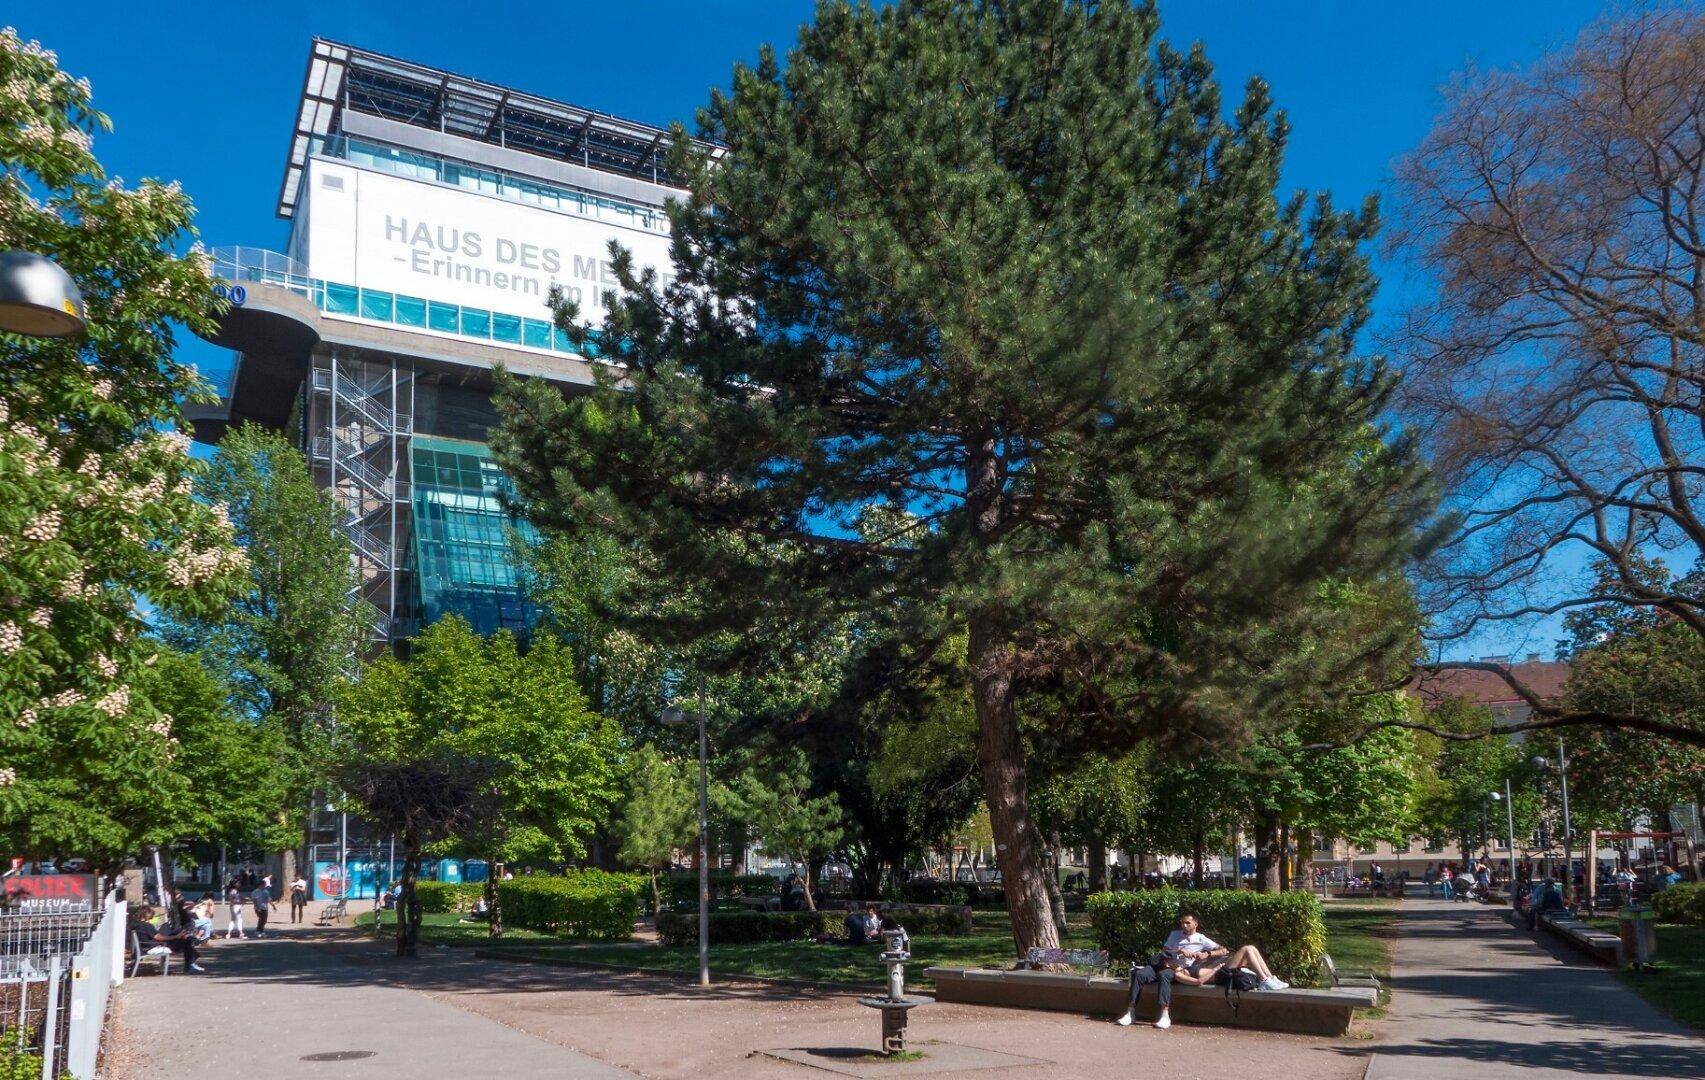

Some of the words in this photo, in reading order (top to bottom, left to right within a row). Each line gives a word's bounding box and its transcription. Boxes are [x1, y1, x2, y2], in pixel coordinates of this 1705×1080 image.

[385, 215, 483, 258] HAUS
[496, 237, 561, 274] DES
[20, 898, 70, 908] MUSEUM
